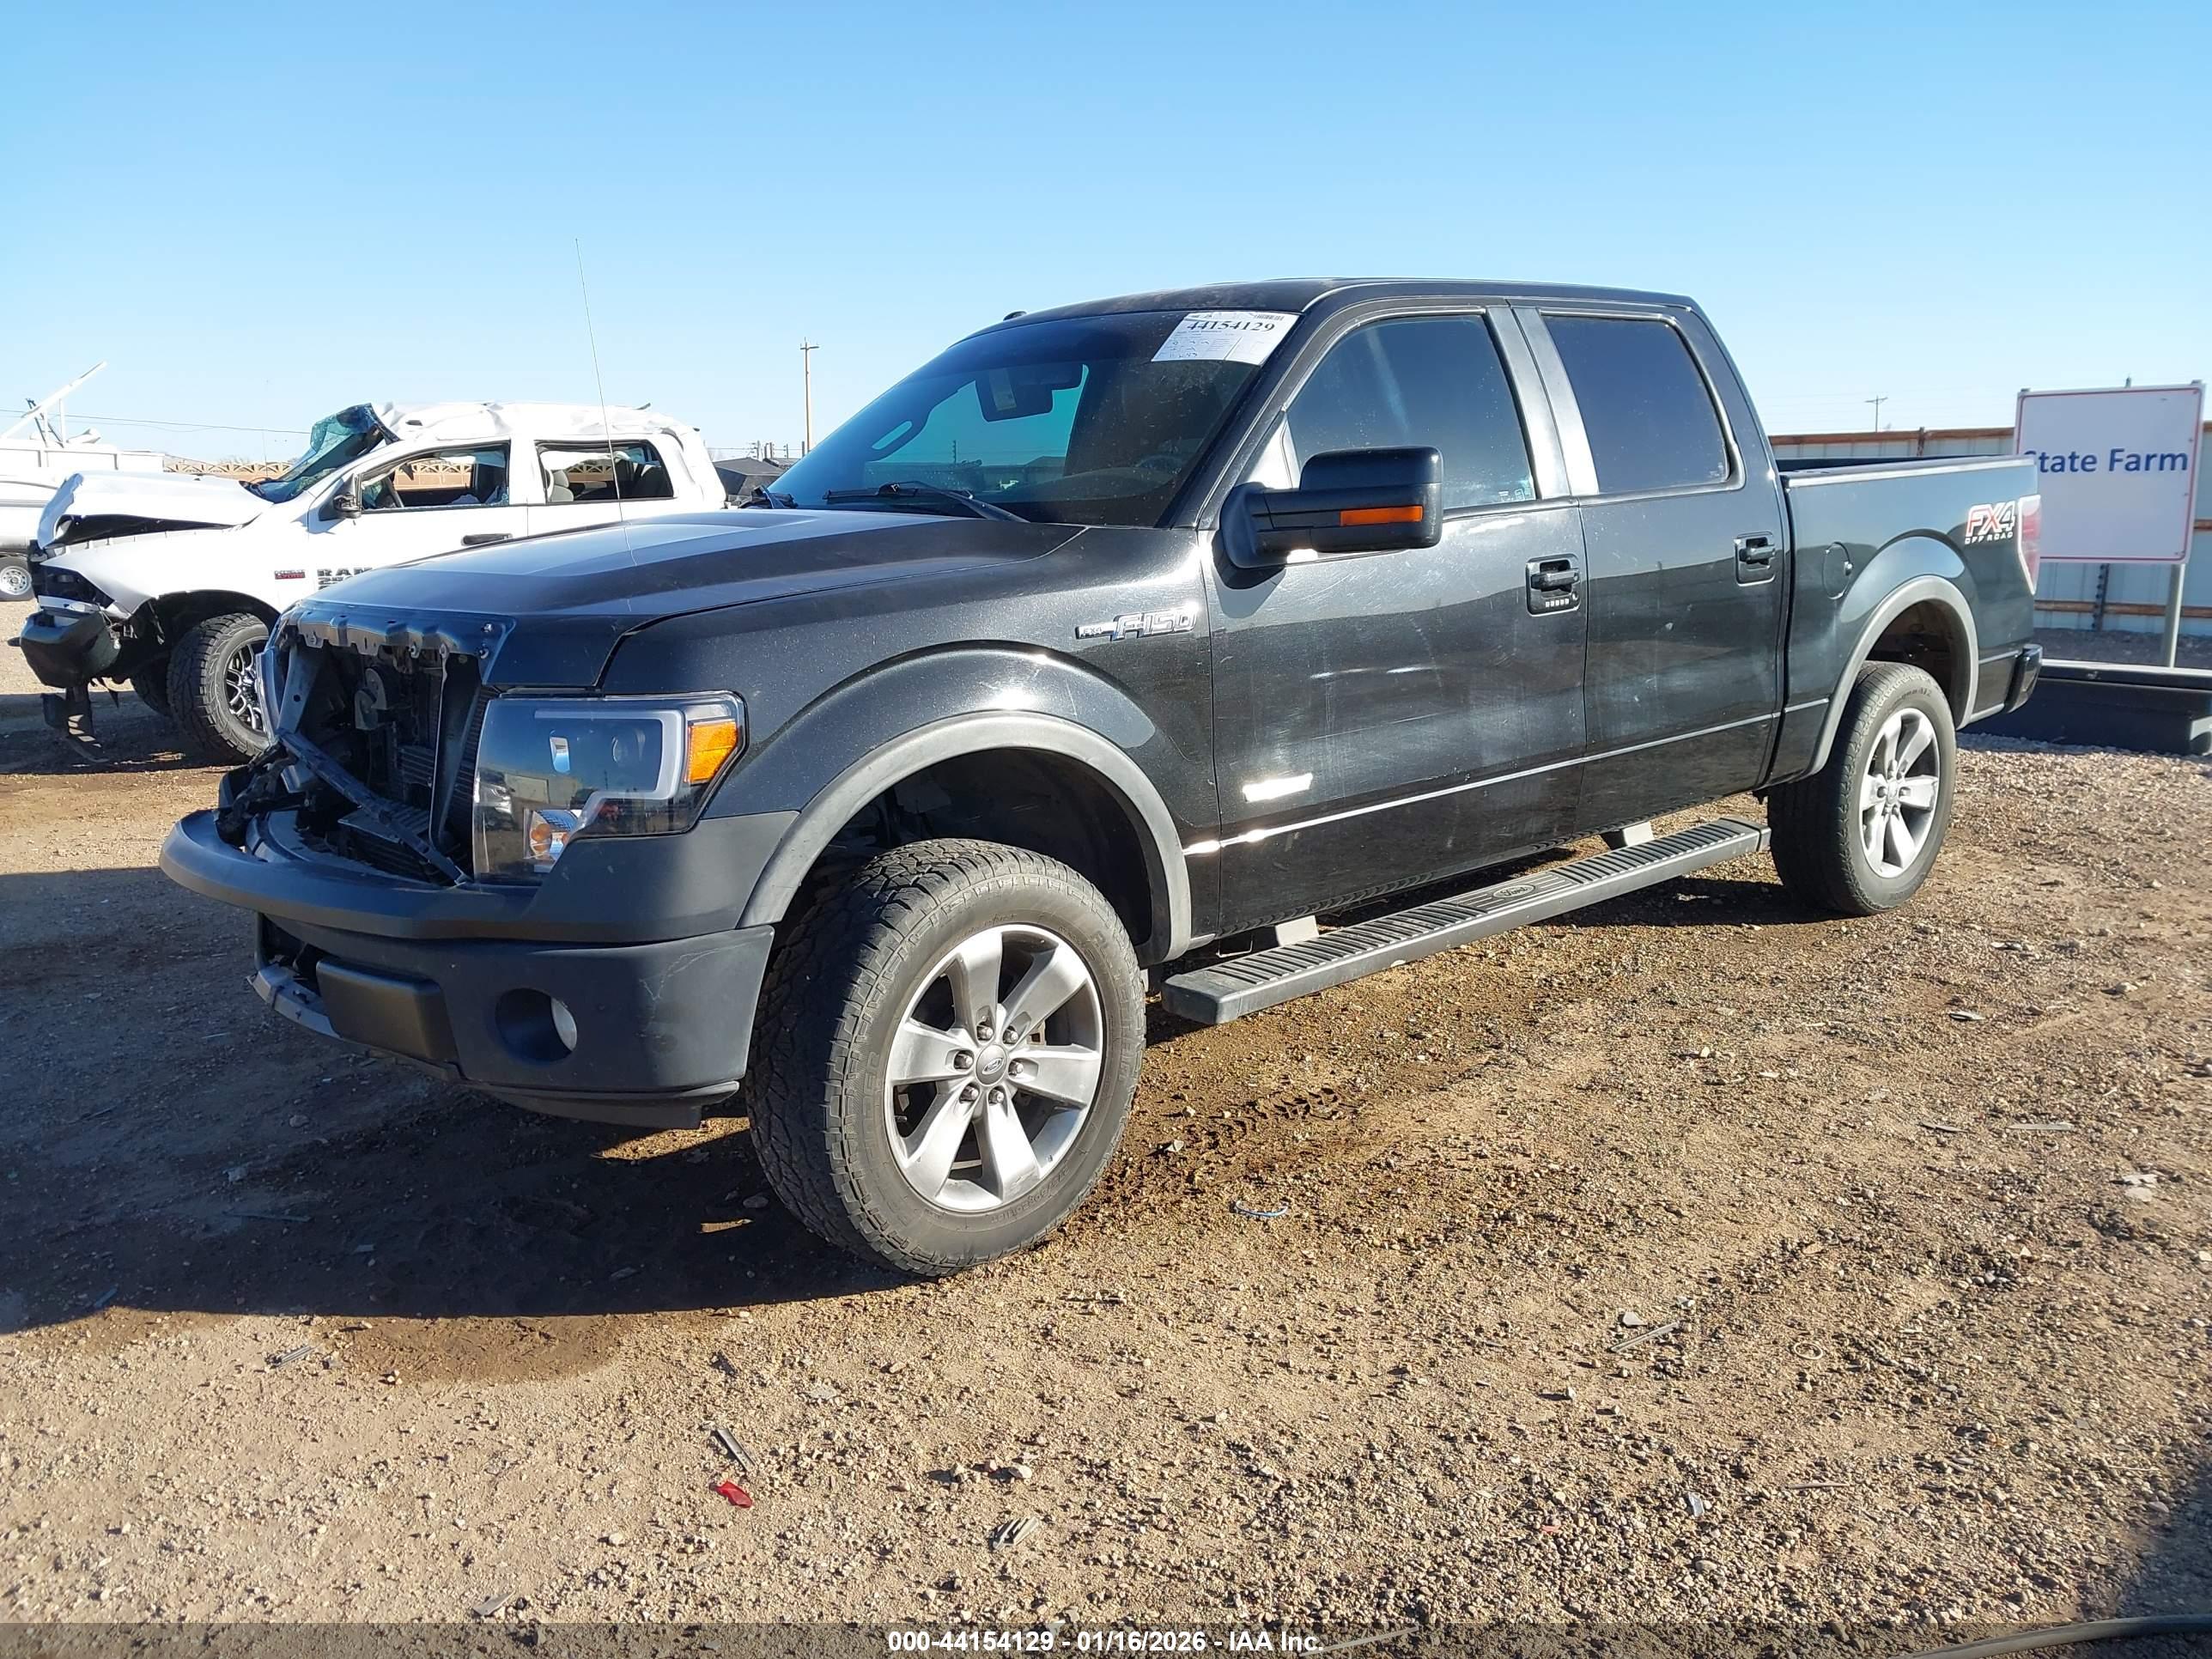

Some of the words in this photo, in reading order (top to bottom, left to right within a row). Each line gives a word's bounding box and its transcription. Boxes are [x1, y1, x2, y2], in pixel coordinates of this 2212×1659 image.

[1187, 319, 1276, 332] 44154129
[2024, 450, 2098, 473] tate
[2108, 447, 2189, 472] Farm
[1965, 500, 2015, 538] FX4
[1964, 535, 1985, 545] OFF
[1986, 531, 2014, 542] ROAD
